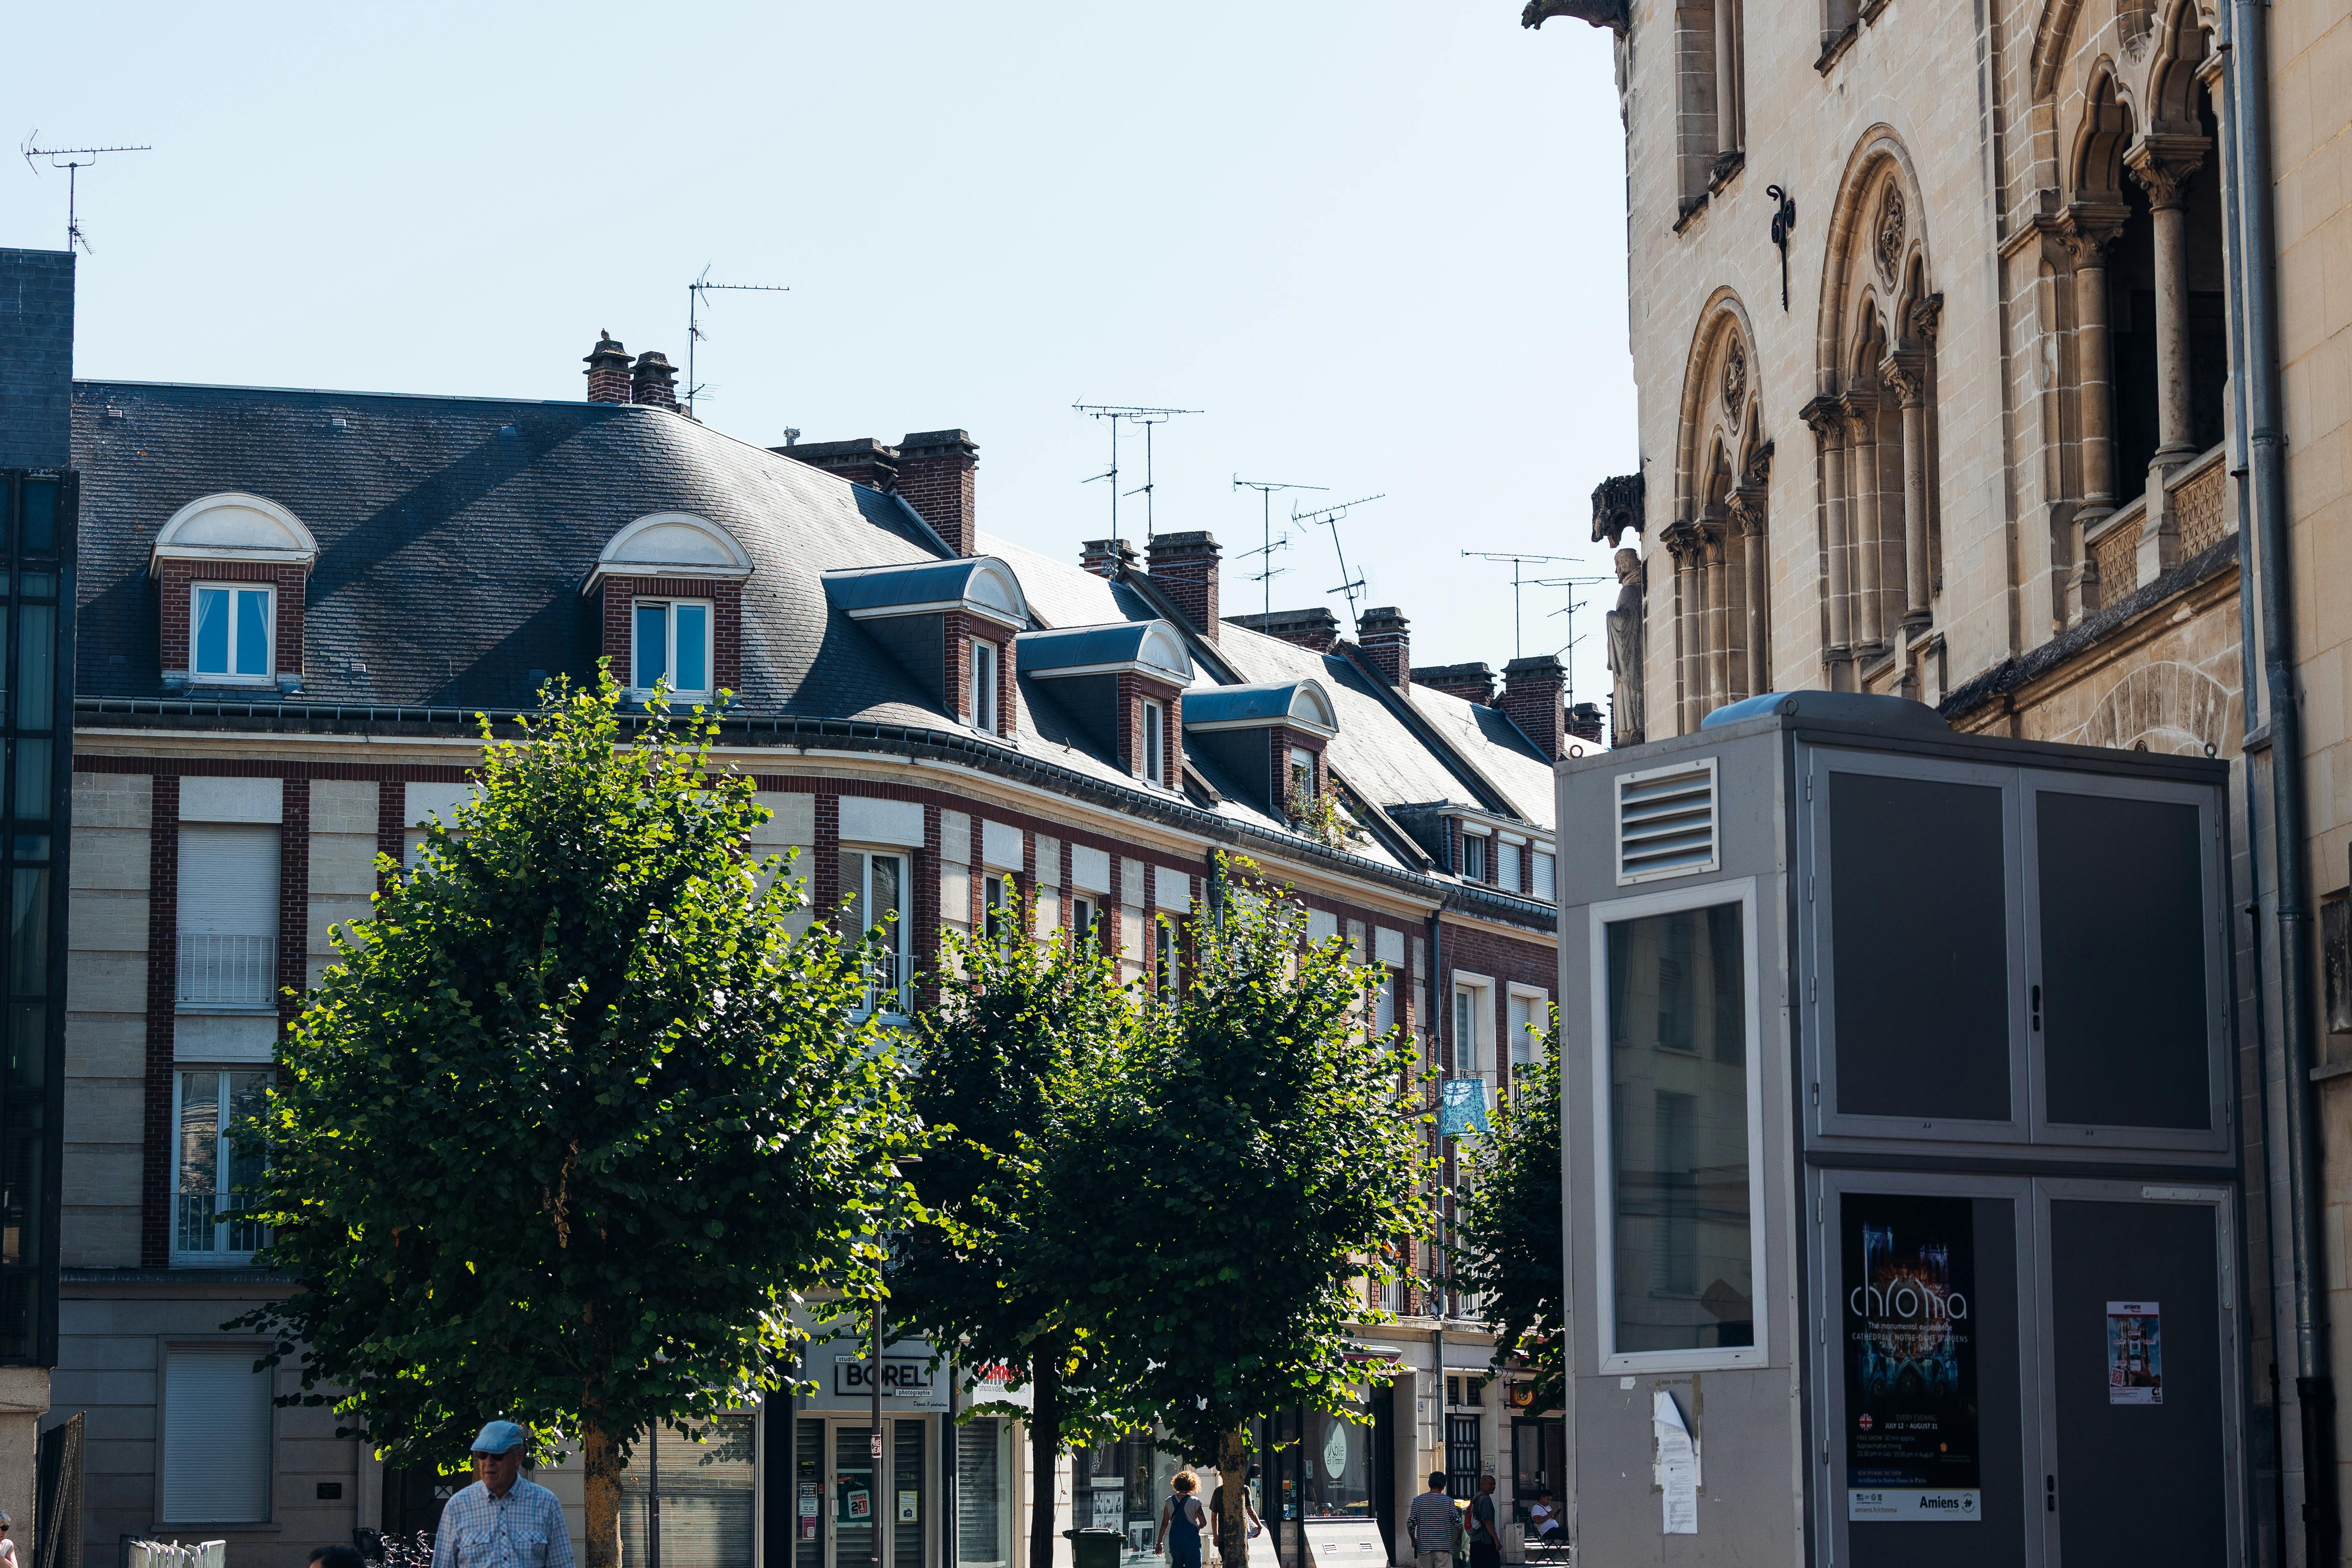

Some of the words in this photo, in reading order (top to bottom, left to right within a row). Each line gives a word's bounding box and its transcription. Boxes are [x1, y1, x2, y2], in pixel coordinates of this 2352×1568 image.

[1851, 1246, 1966, 1319] chroma
[1881, 1322, 1917, 1331] monumental
[1919, 1323, 1952, 1332] experience
[1894, 1333, 1936, 1342] NOTRE-DAME
[847, 1365, 927, 1386] BOREL
[851, 1501, 858, 1512] 2
[1920, 1495, 1959, 1508] Amiens
